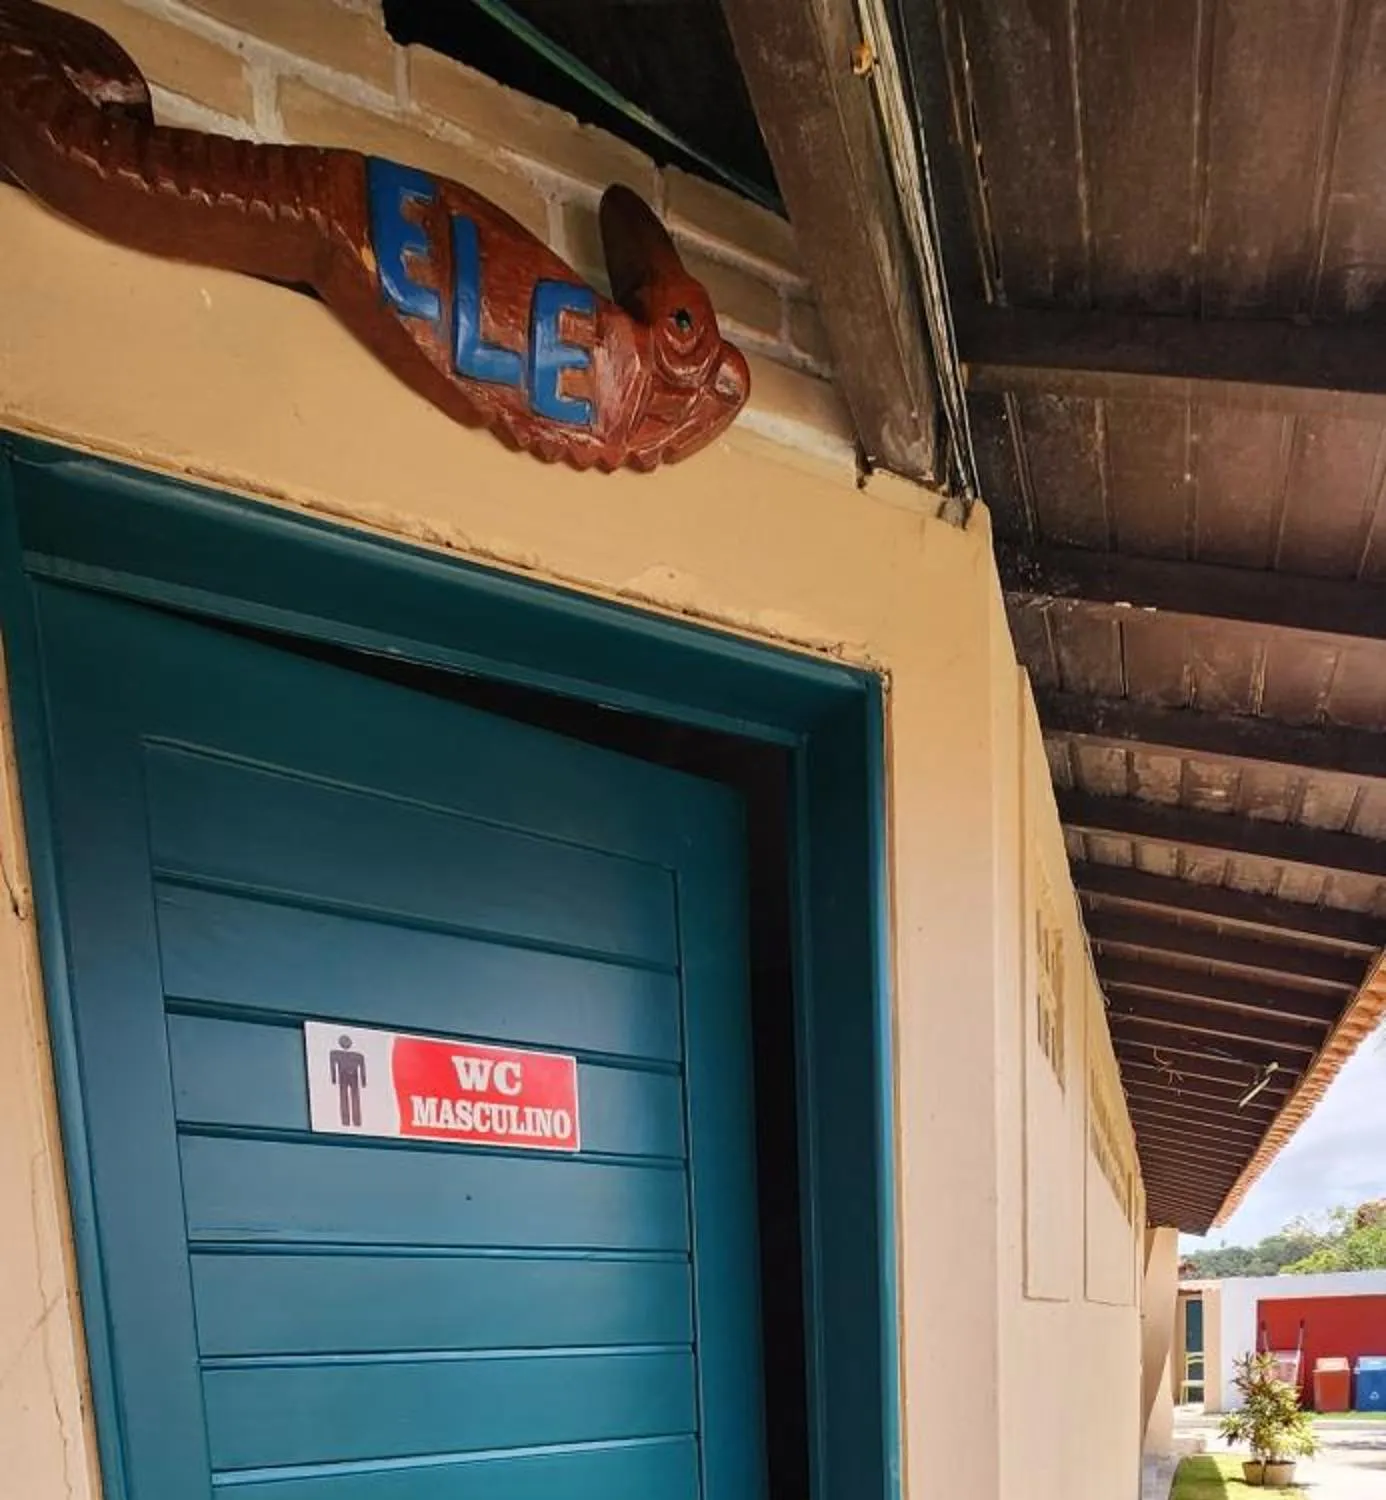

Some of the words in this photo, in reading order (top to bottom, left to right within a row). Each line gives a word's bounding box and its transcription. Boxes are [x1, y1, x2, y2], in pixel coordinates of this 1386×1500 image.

[366, 155, 596, 426] ELE
[451, 1056, 522, 1095] WC
[410, 1096, 572, 1139] MASCULINO
